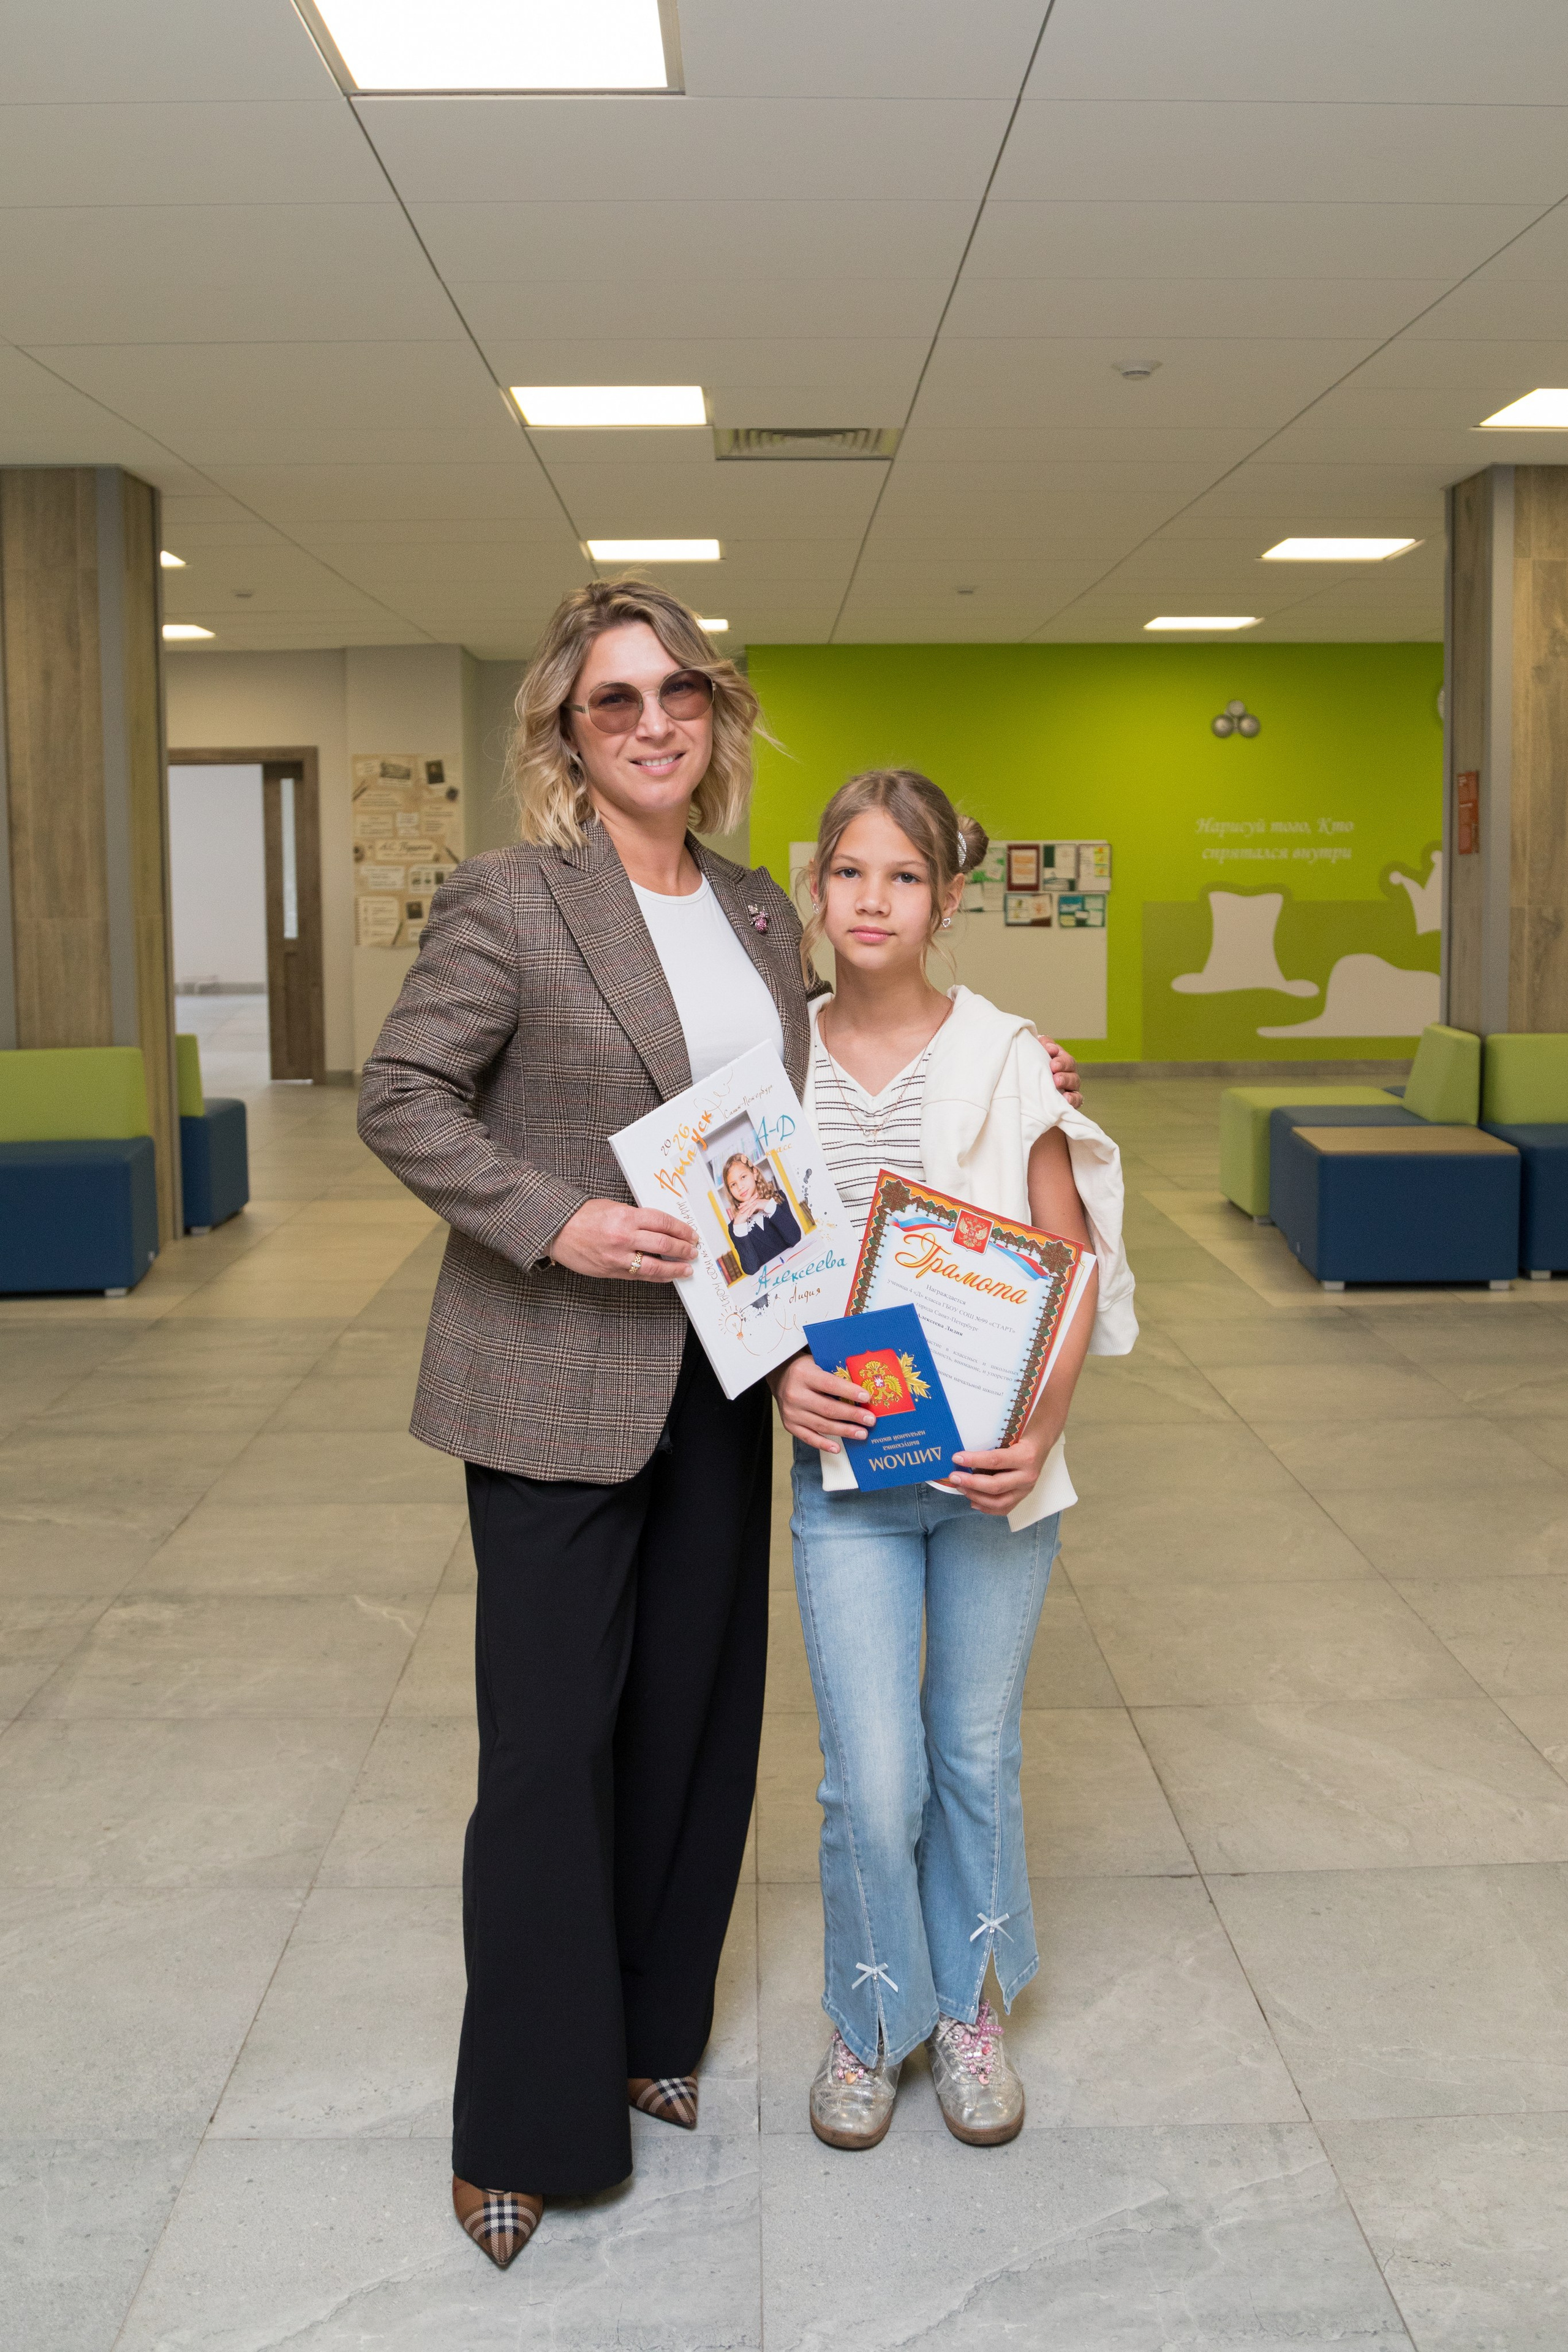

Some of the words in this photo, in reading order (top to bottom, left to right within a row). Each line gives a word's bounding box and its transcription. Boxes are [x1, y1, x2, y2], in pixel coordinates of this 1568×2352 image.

[1196, 817, 1266, 838] Нарисуй
[1270, 821, 1311, 835] того,
[1317, 817, 1354, 837] Кто
[1202, 848, 1289, 864] спрятался
[1292, 848, 1352, 864] внутри
[654, 1110, 712, 1199] Выпуск
[755, 1250, 848, 1295] Алексеева
[894, 1232, 1028, 1304] Грамота
[789, 1285, 821, 1303] Лидия
[926, 1284, 966, 1305] Награждается
[887, 1279, 908, 1291] ученица
[924, 1294, 941, 1306] класса
[942, 1302, 958, 1313] ГБОУ
[959, 1309, 974, 1320] СОШ
[974, 1315, 988, 1325] №99
[989, 1321, 1016, 1334] «СТАРТ»
[916, 1302, 933, 1313] города
[934, 1309, 979, 1333] Санкт-Петербург
[944, 1325, 963, 1336] Лидия
[953, 1351, 978, 1363] классных
[990, 1365, 1019, 1376] школьных
[954, 1376, 981, 1390] начальной
[982, 1387, 1004, 1396] школы!
[987, 1371, 1012, 1382] упорство
[871, 1436, 892, 1444] школы
[883, 1440, 920, 1451] выпускника
[892, 1430, 926, 1441] начальной
[868, 1446, 941, 1472] ДИПЛОМ
